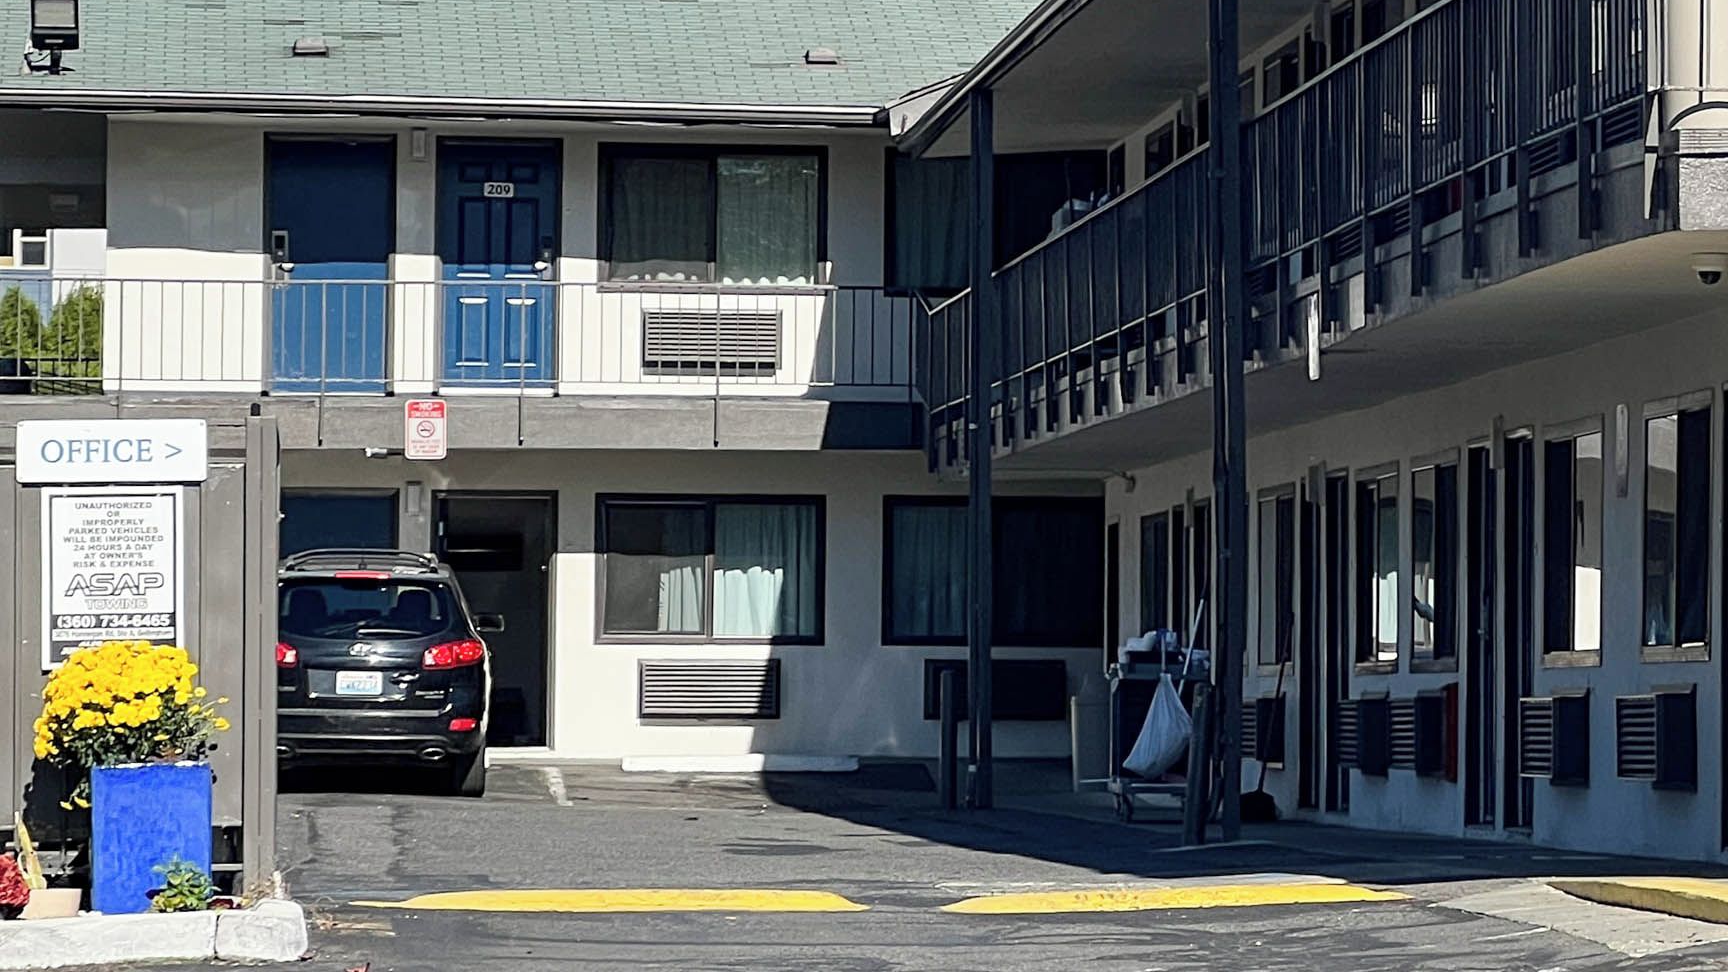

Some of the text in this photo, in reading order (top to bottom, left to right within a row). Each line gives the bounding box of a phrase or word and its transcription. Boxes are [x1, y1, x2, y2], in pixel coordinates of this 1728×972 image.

[487, 184, 511, 195] 209
[40, 439, 153, 463] OFFICE
[106, 510, 121, 518] OR
[82, 518, 144, 526] IMPROPERLY
[69, 526, 159, 535] PARKED VEHICLES
[64, 572, 164, 597] ASAP
[84, 598, 148, 610] TOWING
[57, 614, 171, 628] (360) 734-6465
